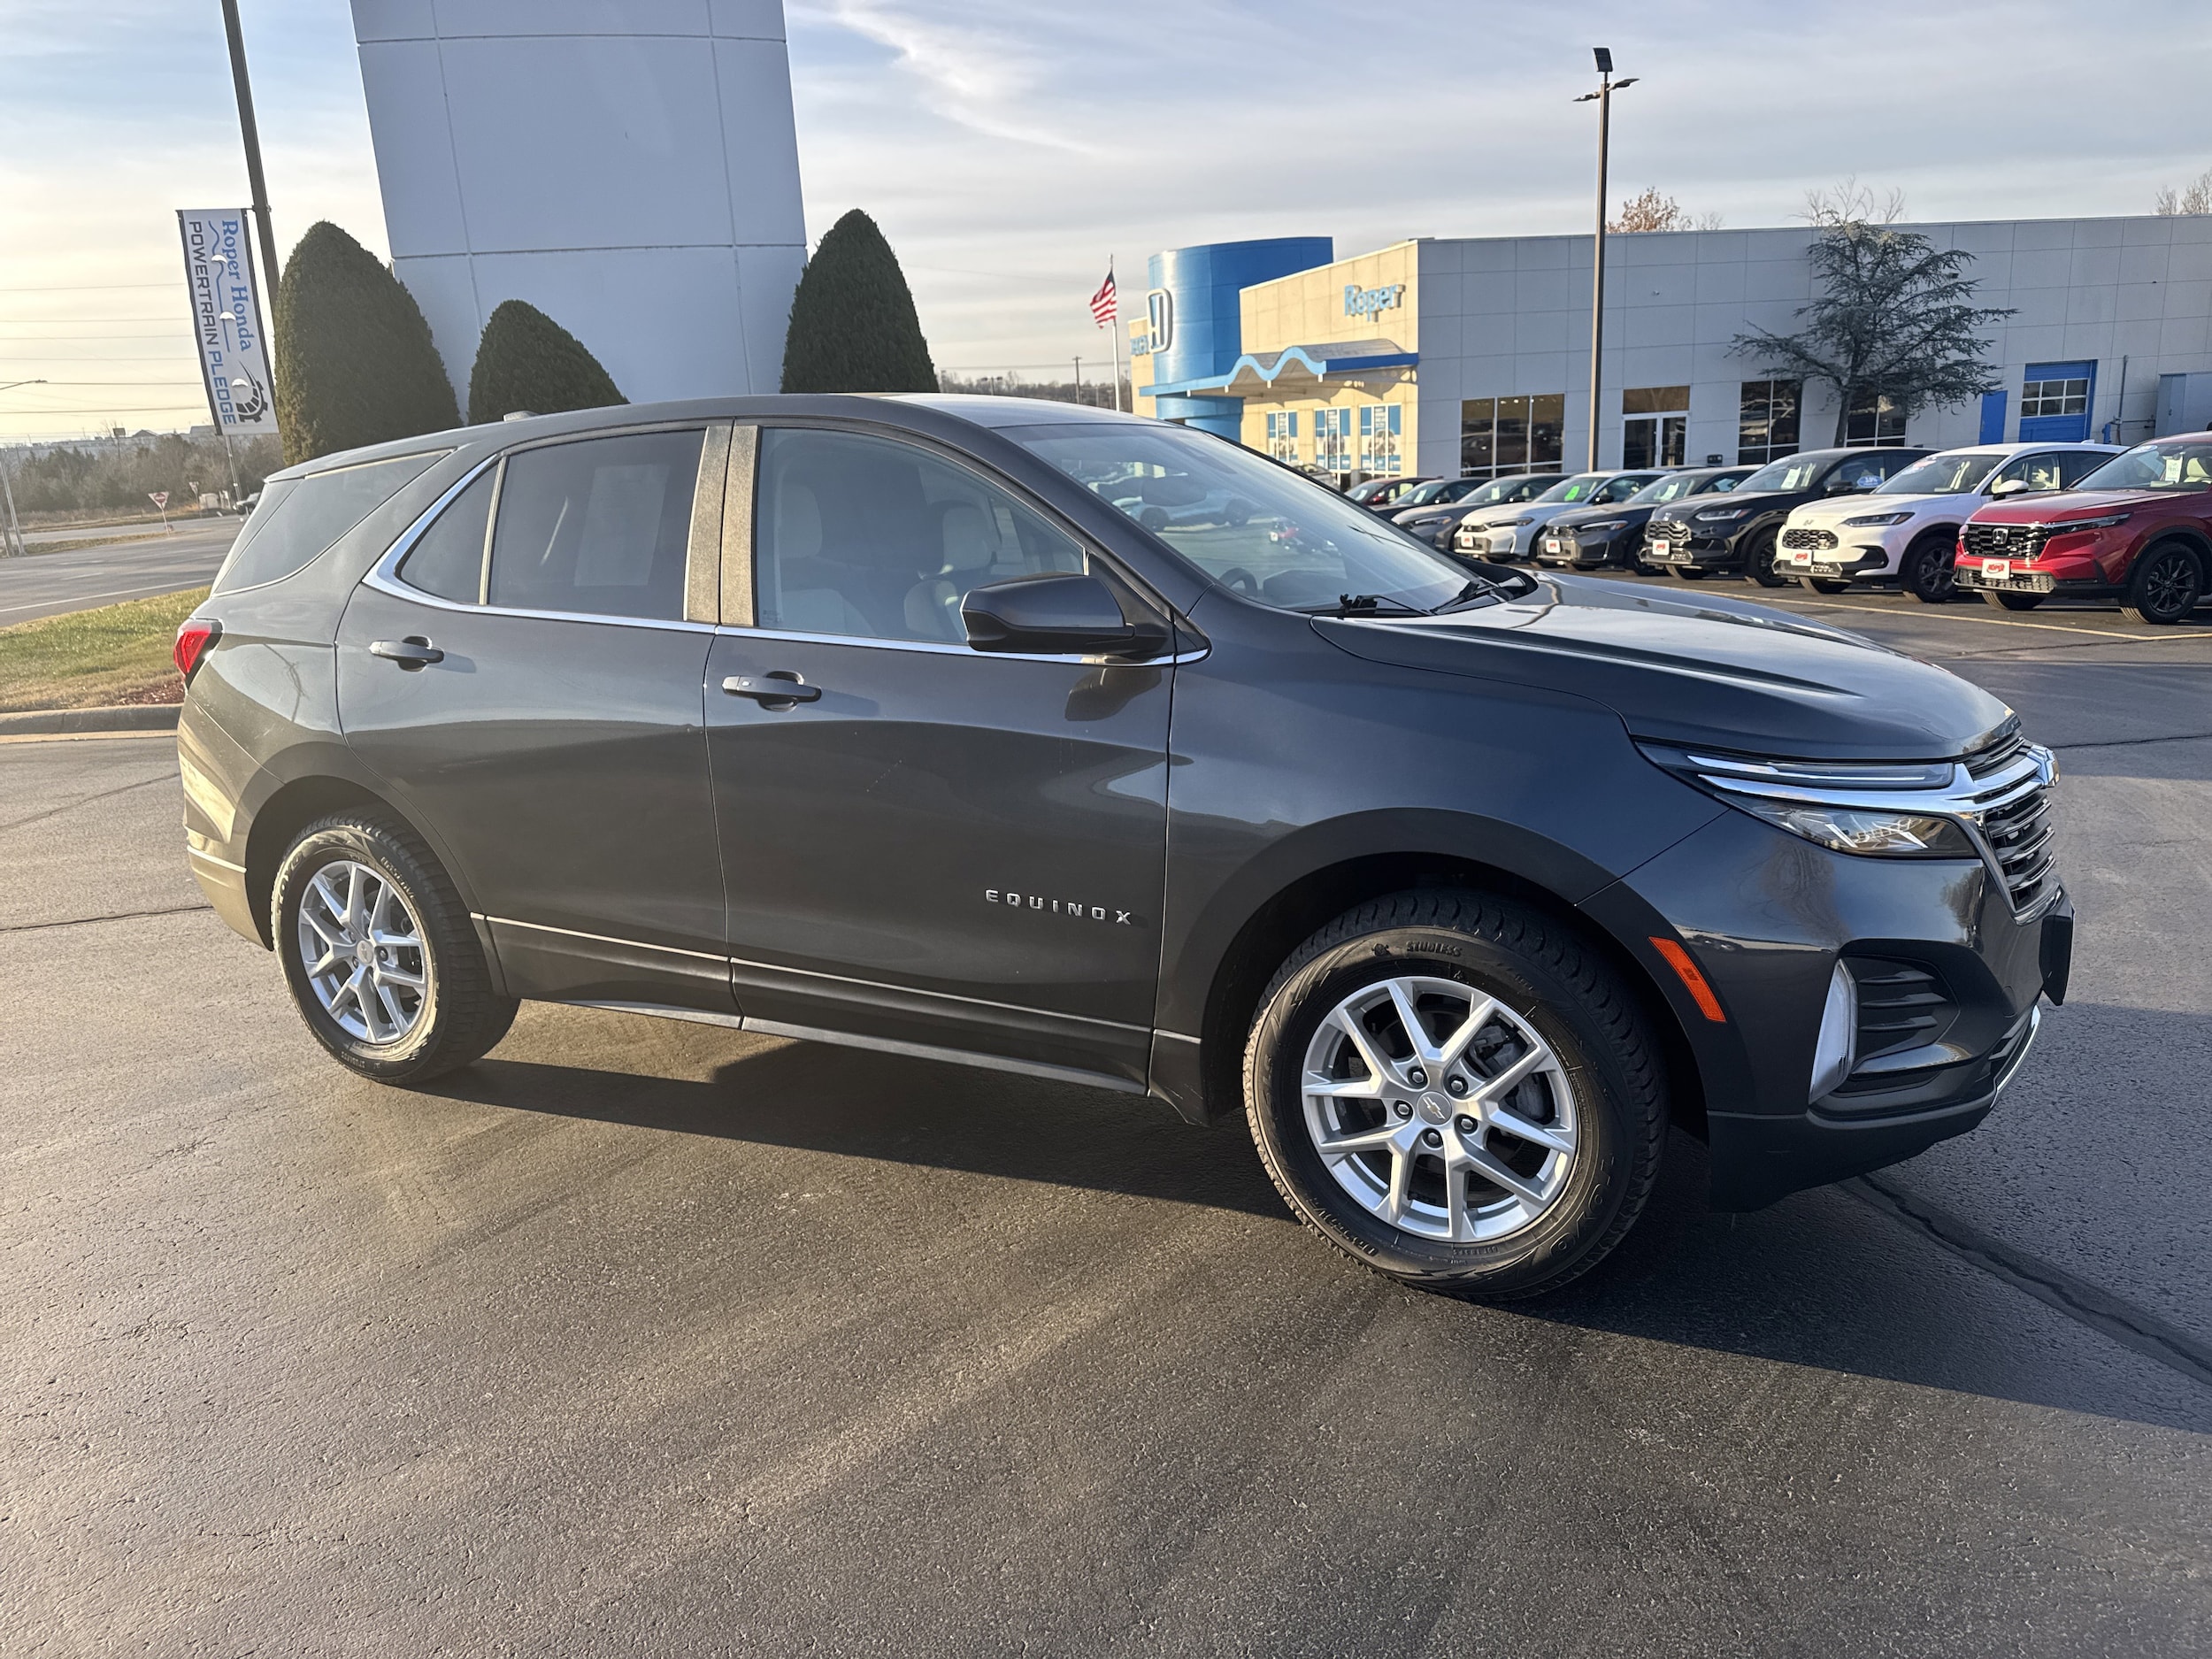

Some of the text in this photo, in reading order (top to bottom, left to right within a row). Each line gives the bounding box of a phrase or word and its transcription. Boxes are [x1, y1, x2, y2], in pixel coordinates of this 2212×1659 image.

[222, 219, 254, 351] Roper Honda
[1344, 284, 1402, 322] Roper
[189, 221, 236, 425] POWERTRAIN PLEDGE
[985, 889, 1132, 926] EQUINOX
[1406, 940, 1463, 958] STUDLESS
[1549, 1152, 1616, 1261] TOYO
